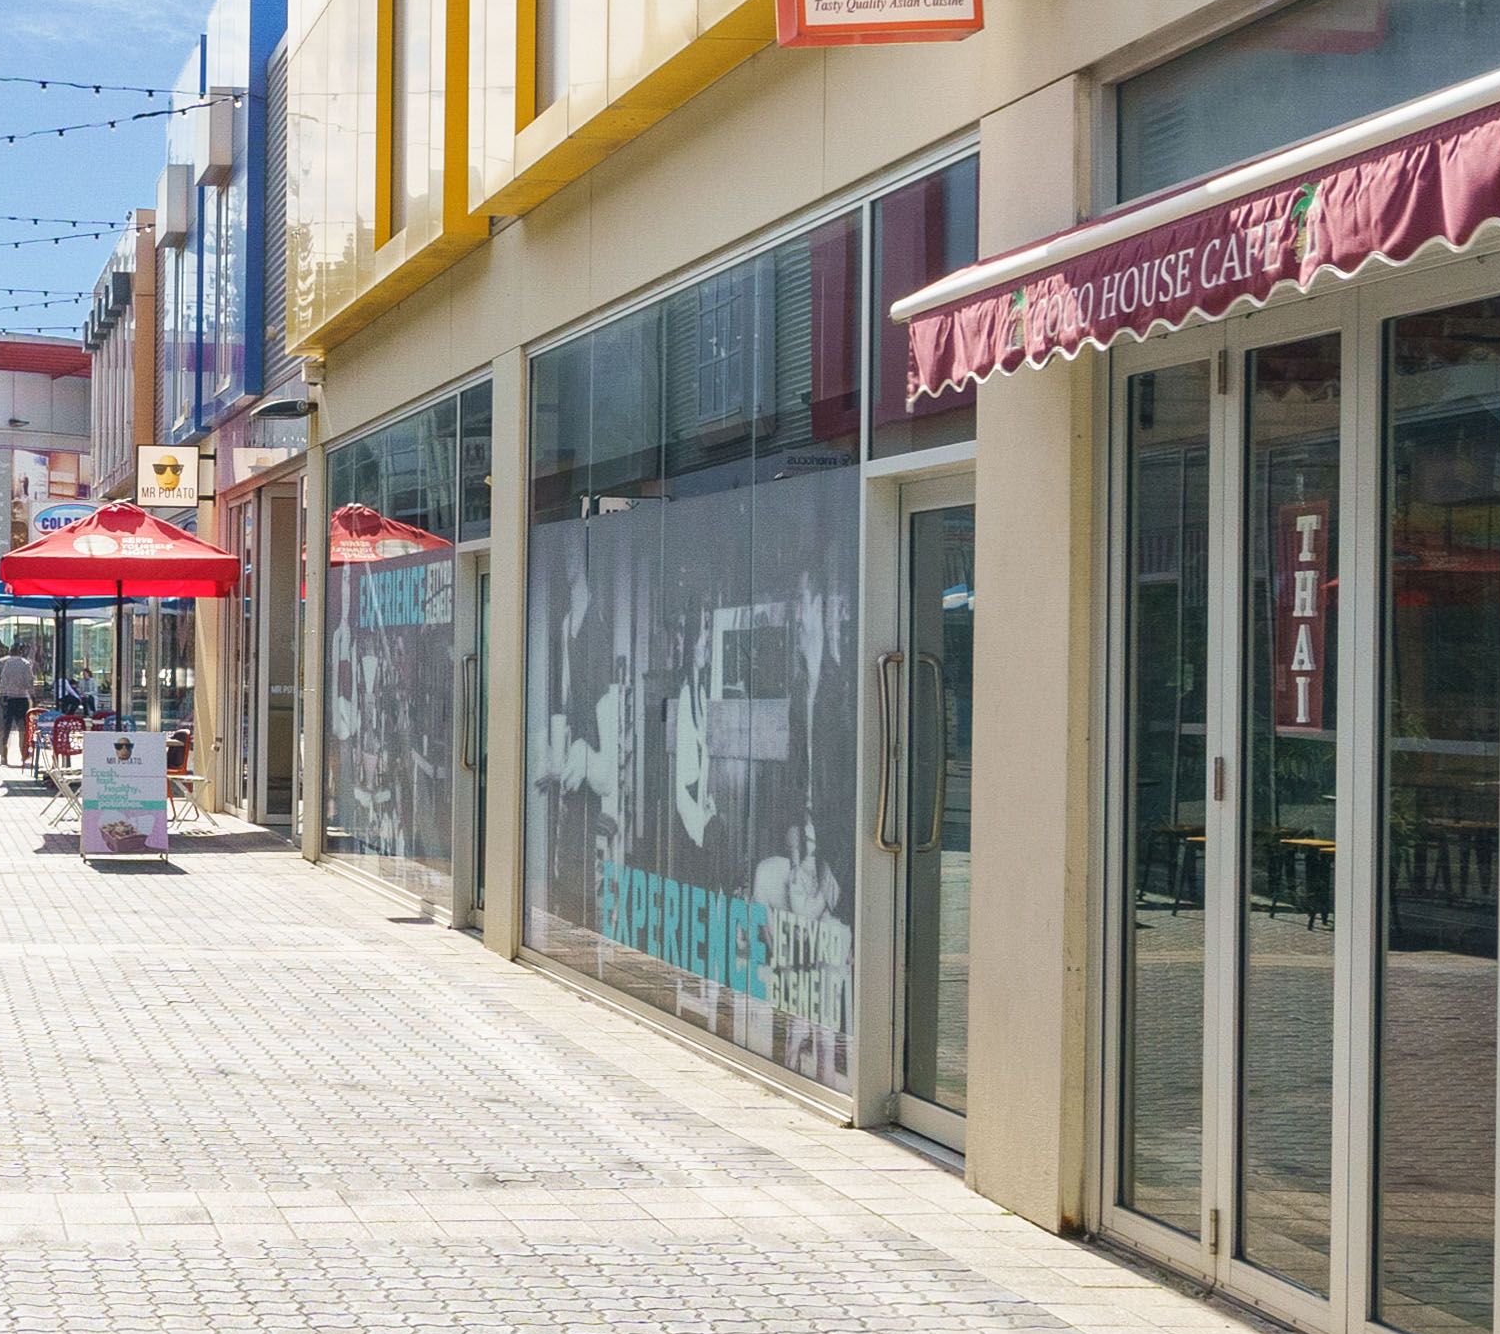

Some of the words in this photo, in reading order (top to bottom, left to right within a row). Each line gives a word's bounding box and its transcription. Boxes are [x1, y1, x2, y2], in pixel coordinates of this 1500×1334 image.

[1031, 281, 1095, 341] COCO
[1098, 247, 1195, 321] HOUSE
[1200, 217, 1284, 289] CAFE
[141, 487, 156, 499] MR
[158, 486, 195, 499] POTATO
[359, 563, 426, 629] EXPERIENCE
[1290, 514, 1322, 724] THAI
[602, 859, 768, 1001] EXPERIENCE
